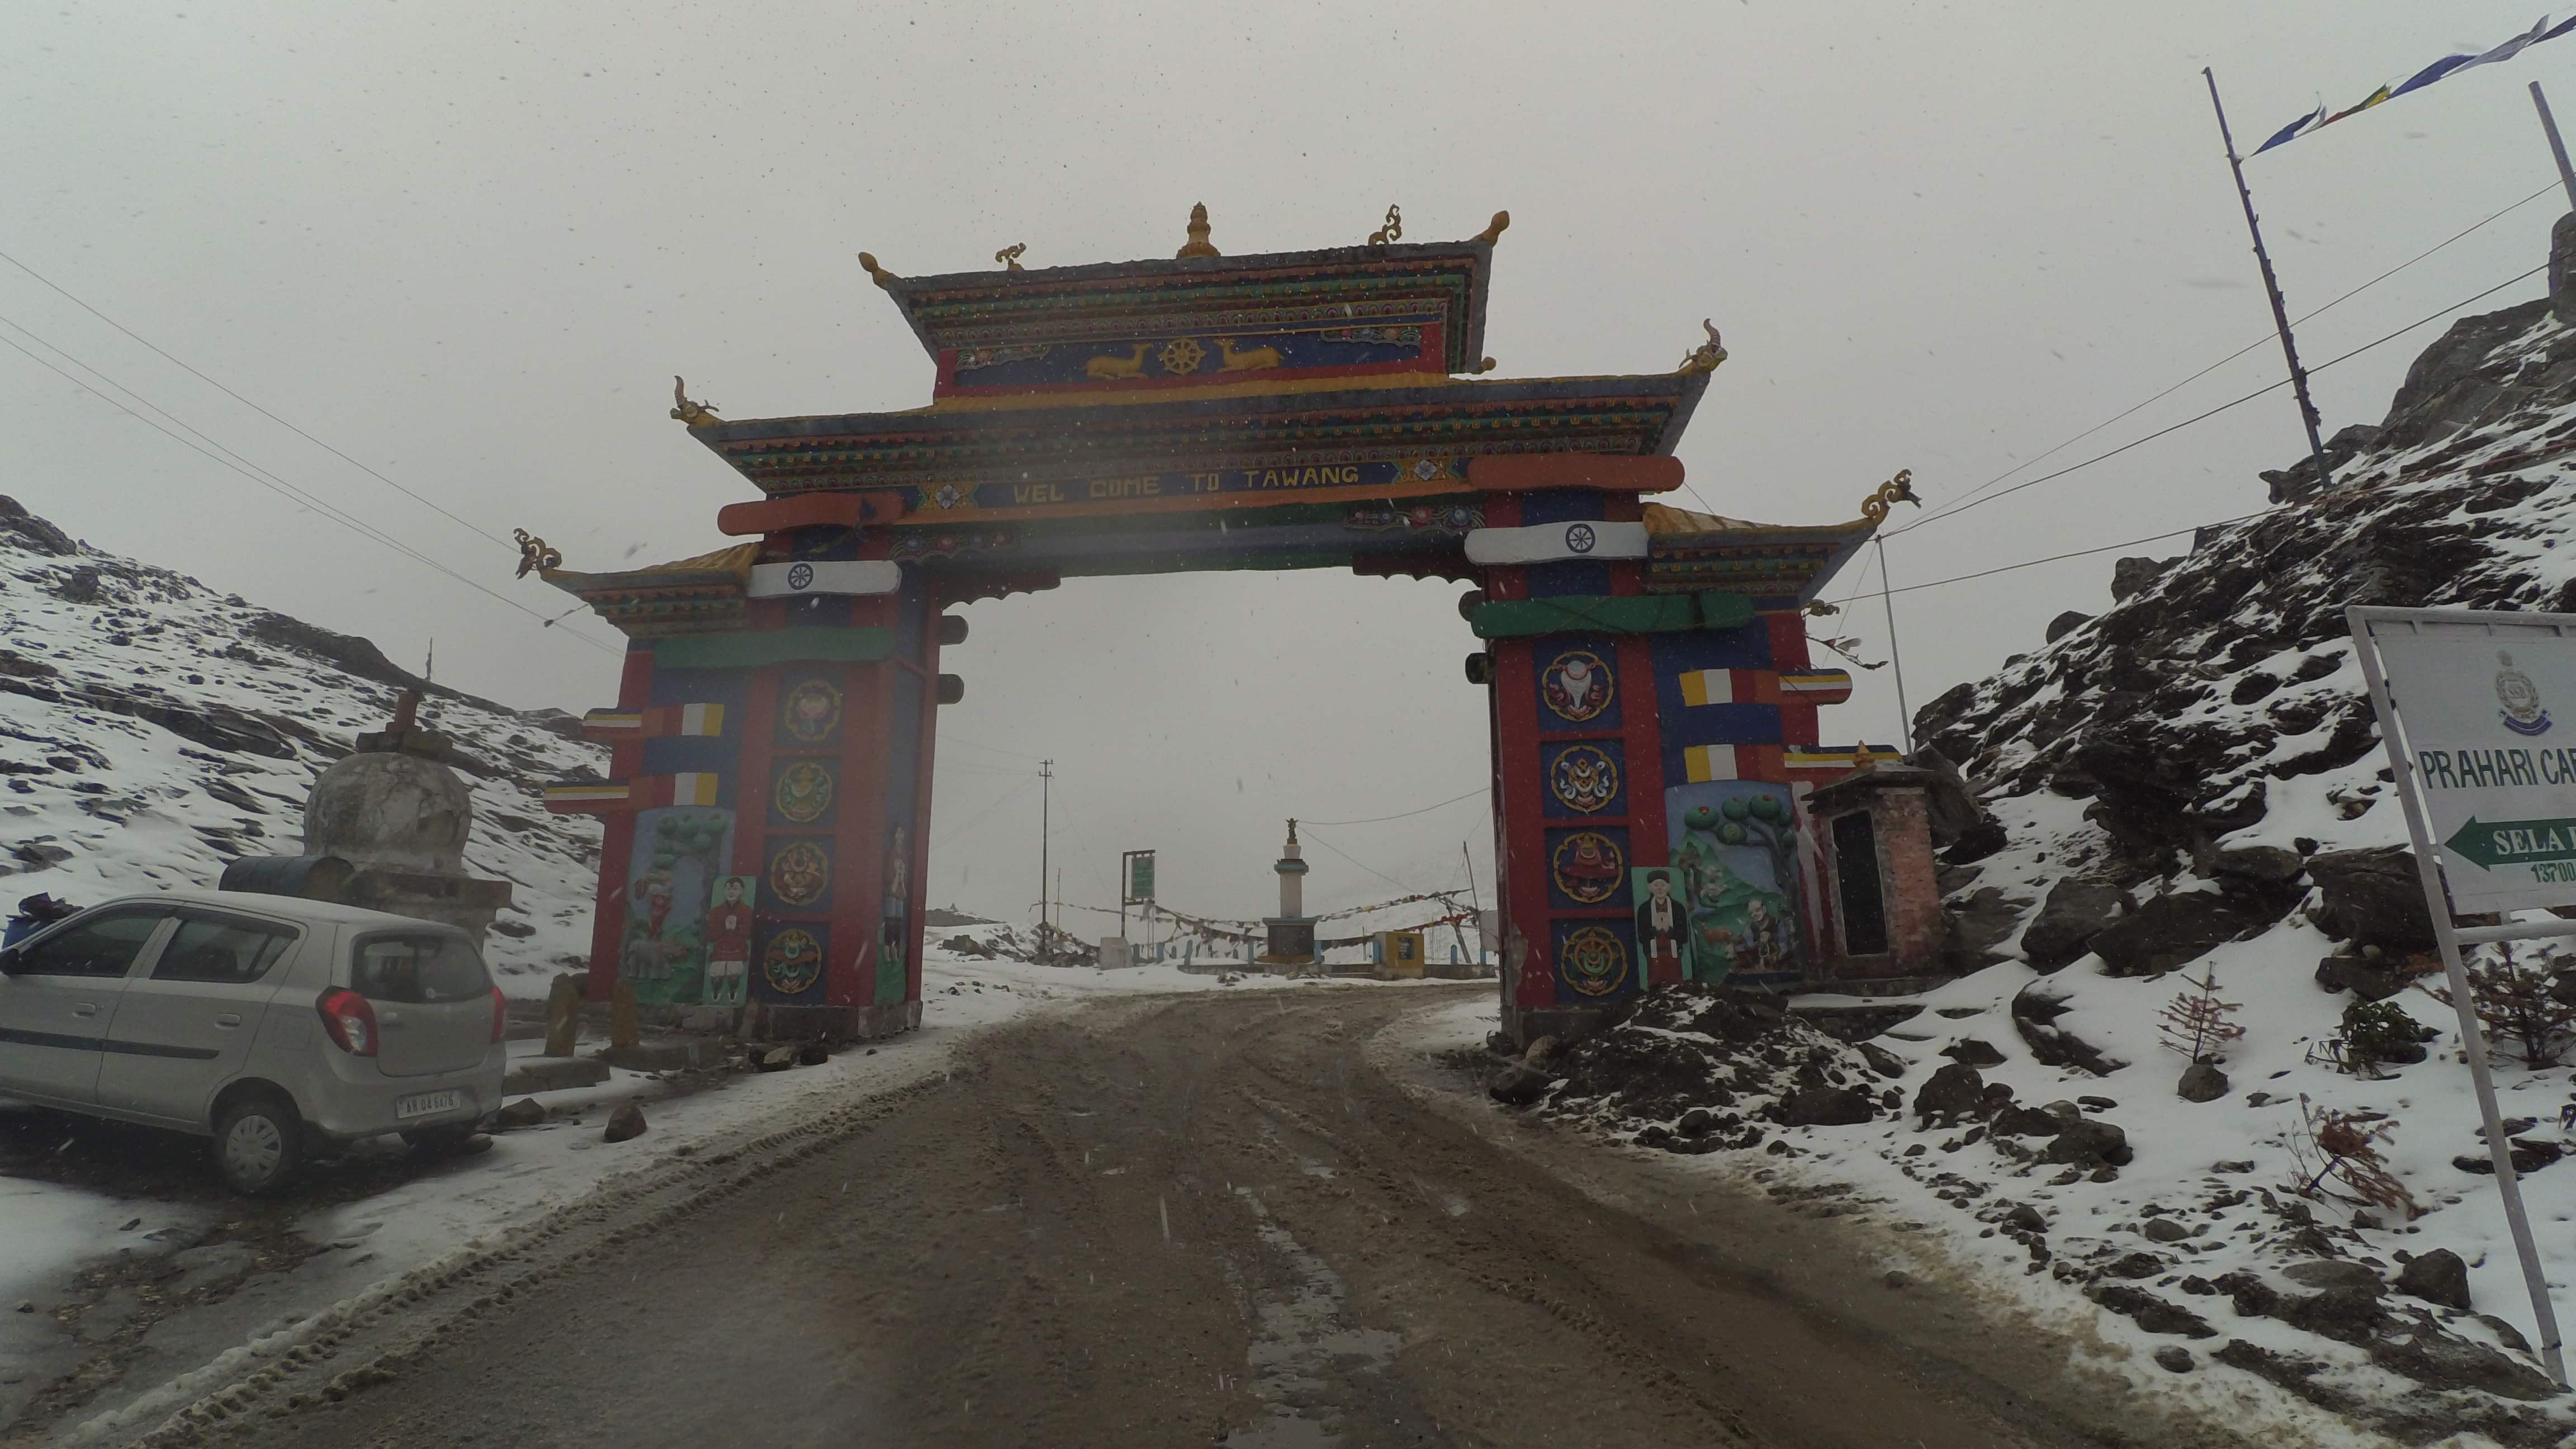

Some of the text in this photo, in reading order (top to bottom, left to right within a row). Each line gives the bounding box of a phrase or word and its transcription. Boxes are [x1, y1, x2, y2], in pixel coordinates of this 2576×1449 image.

[1014, 466, 1360, 503] WEL COME TO TAWANG
[2418, 749, 2539, 789] PRAHARI
[2493, 827, 2567, 855] SELA
